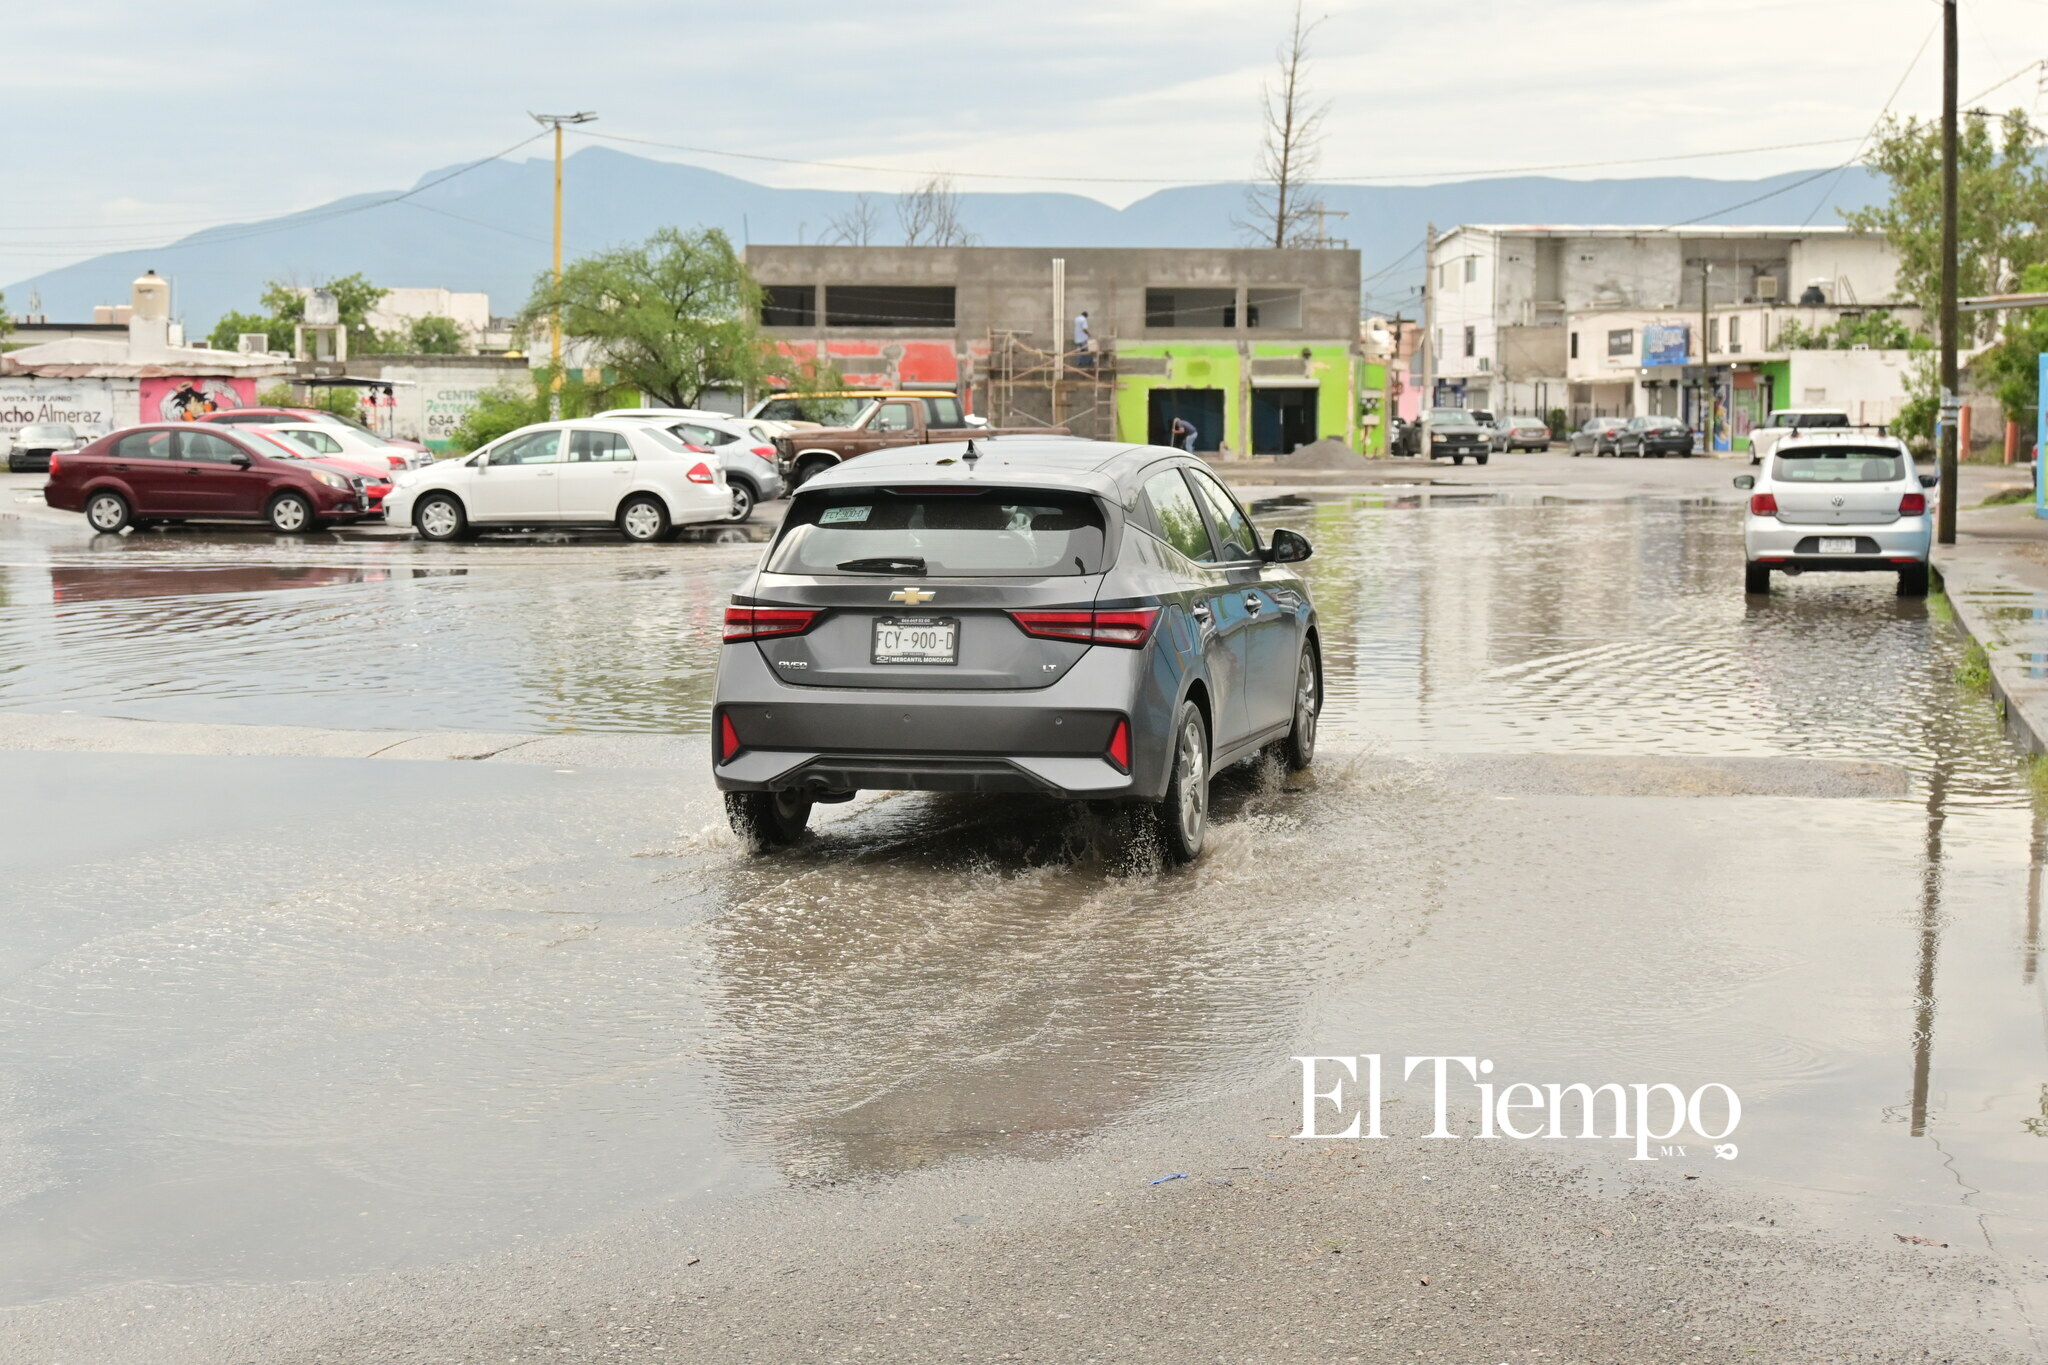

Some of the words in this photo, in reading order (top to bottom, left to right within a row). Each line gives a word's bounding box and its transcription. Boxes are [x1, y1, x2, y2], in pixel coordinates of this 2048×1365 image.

[437, 390, 478, 401] CENTR
[0, 406, 34, 423] cho
[37, 403, 101, 423] Almeraz
[428, 415, 454, 426] 634
[876, 631, 954, 650] FCY-900-D
[1042, 664, 1057, 673] LT
